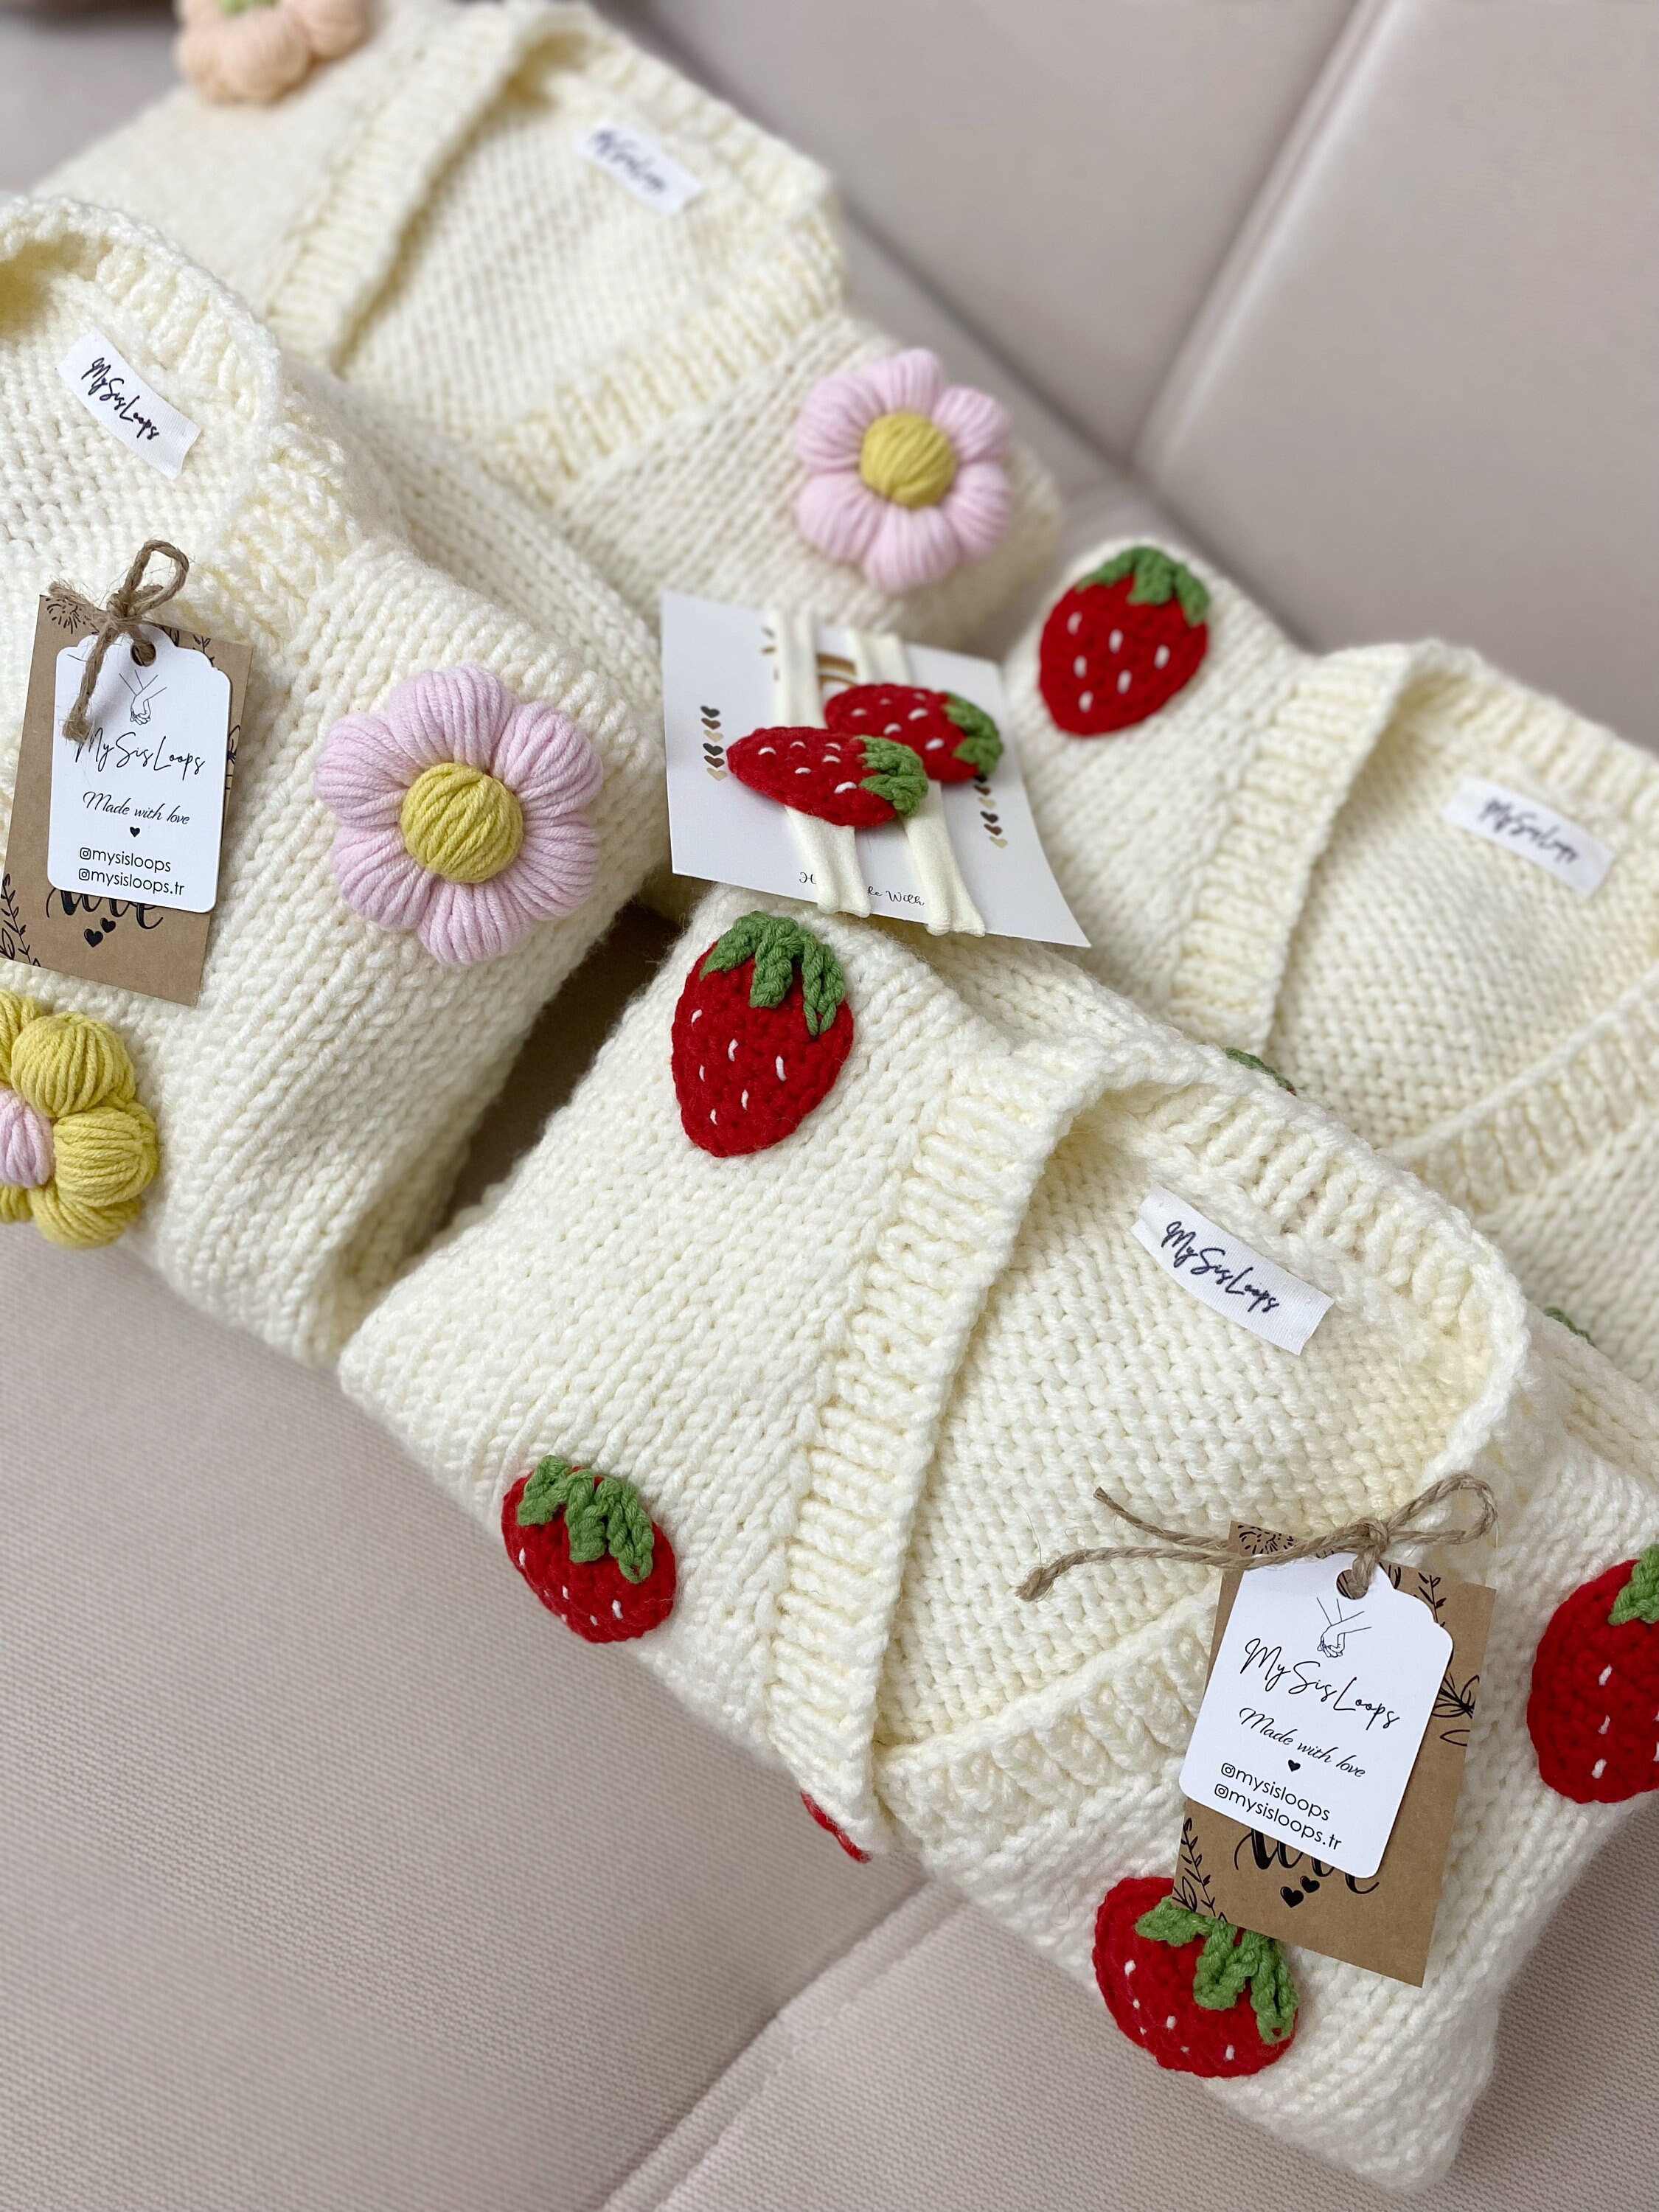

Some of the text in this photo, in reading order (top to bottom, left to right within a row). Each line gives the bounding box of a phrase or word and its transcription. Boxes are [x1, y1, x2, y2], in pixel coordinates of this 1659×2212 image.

[83, 791, 190, 825] Made with love
[886, 890, 925, 906] With
[1239, 1707, 1366, 1778] Made with love
